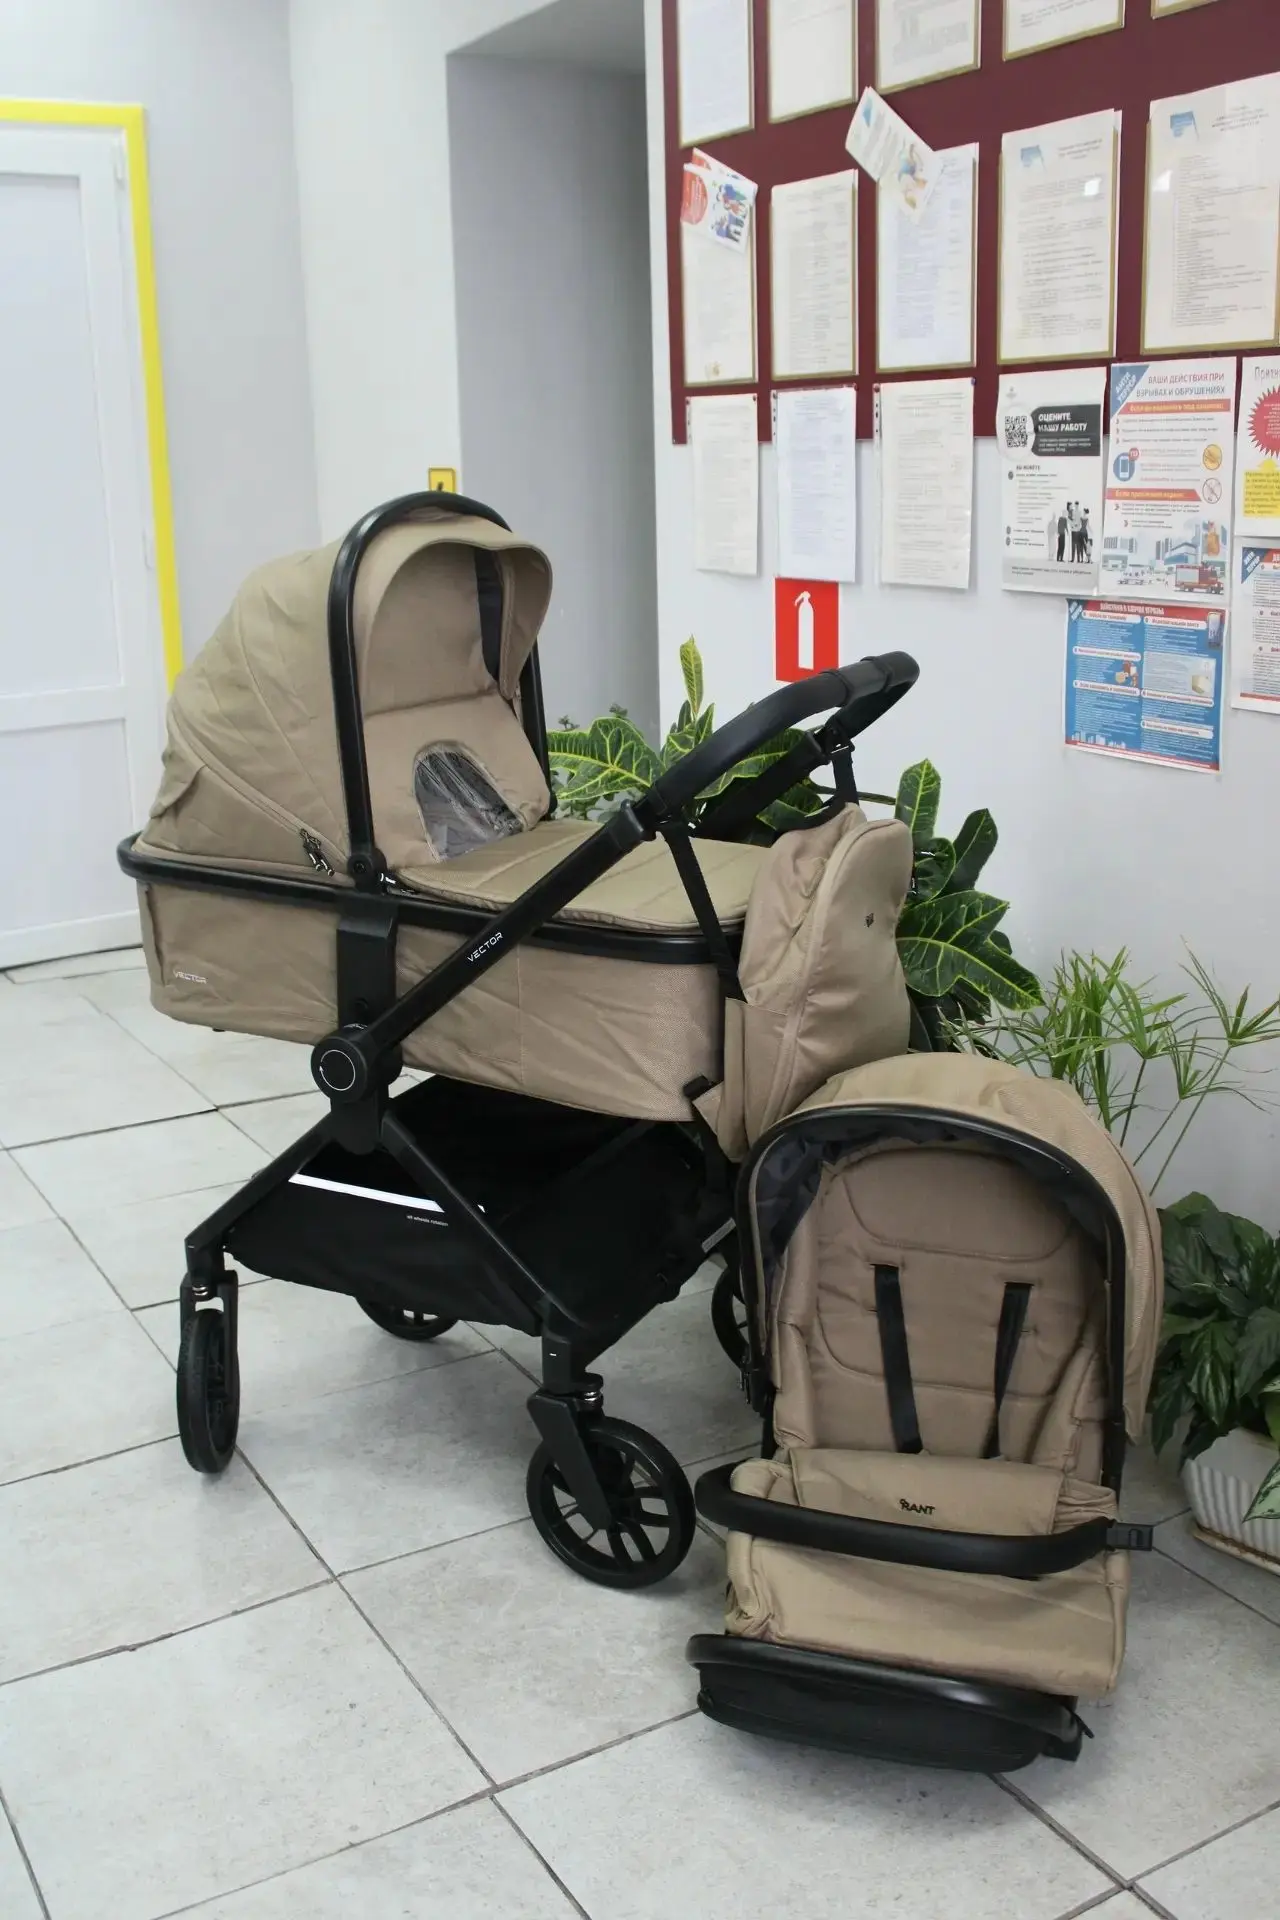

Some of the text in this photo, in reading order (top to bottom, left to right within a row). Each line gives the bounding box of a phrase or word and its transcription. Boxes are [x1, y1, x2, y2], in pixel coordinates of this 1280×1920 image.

[1148, 372, 1225, 385] ВАШИ ДЕЙСТВИЯ ПРИ
[1254, 366, 1280, 385] Призн
[1136, 386, 1225, 398] ВЗРЫВАХ И ОБРУШЕНИЯХ
[1038, 412, 1071, 421] ОЦЕНИТЕ
[1038, 422, 1088, 432] НАШУ РАБОТУ
[467, 932, 503, 962] VECTOR
[172, 969, 207, 984] VECTOR
[899, 1498, 936, 1515] RANT
